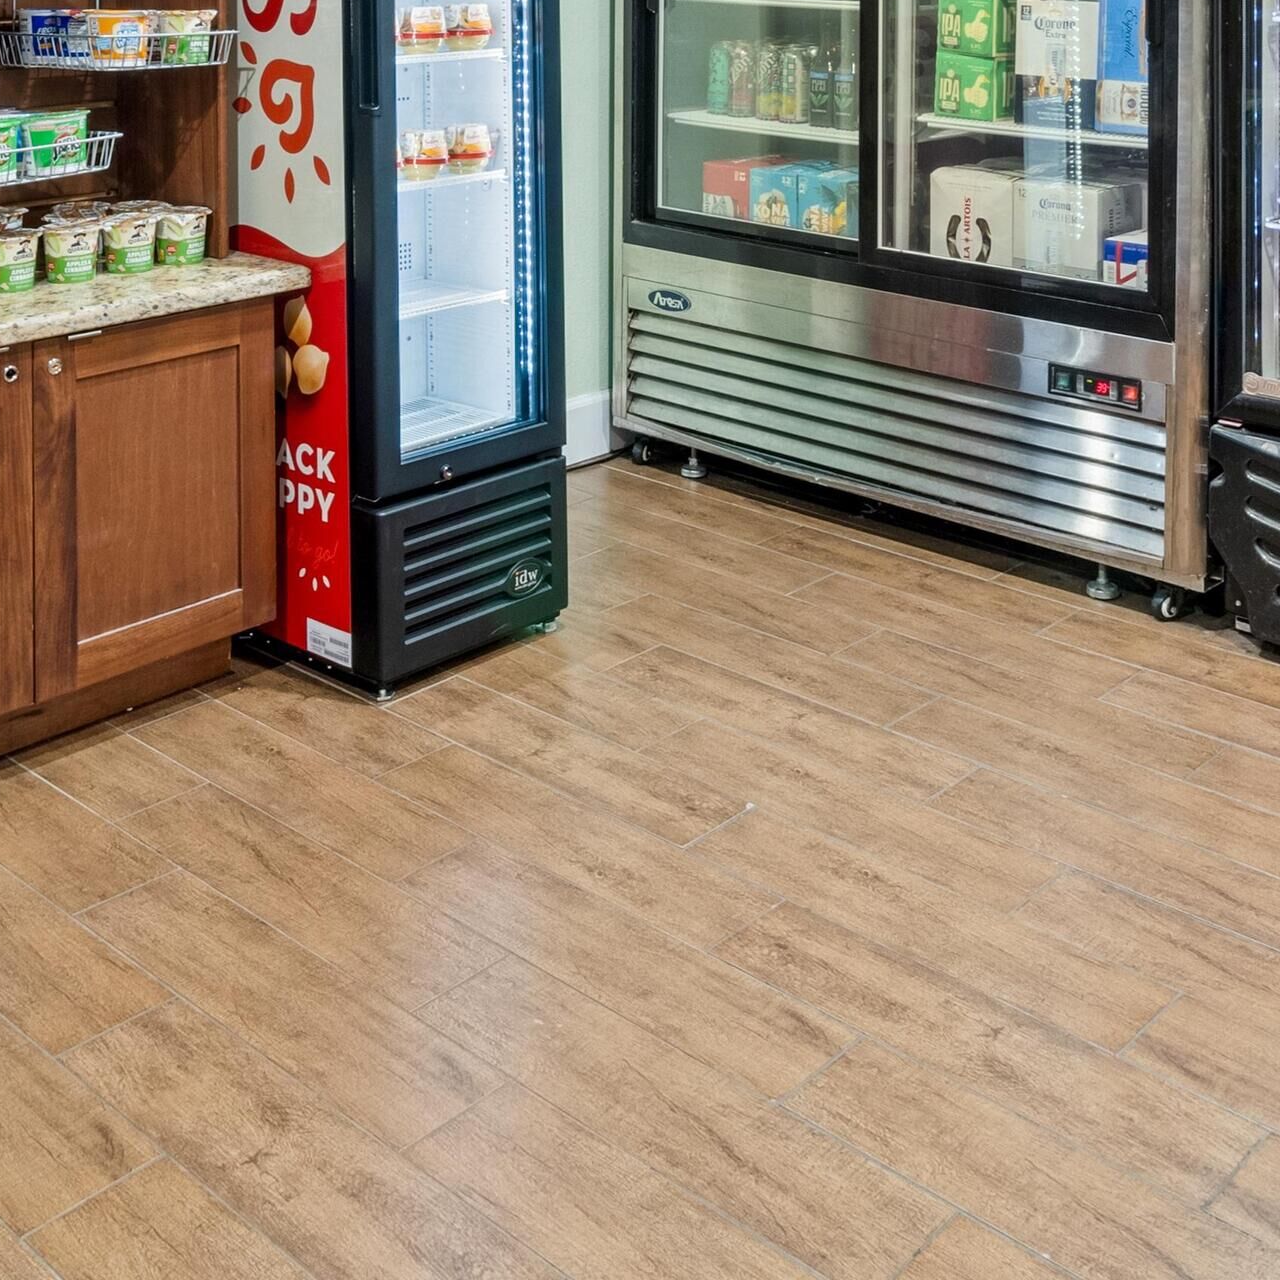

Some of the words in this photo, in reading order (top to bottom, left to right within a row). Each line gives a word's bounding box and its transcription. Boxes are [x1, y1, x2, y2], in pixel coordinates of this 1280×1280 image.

[942, 13, 961, 37] IPA
[1044, 31, 1067, 40] Extra
[939, 78, 960, 102] IPA
[754, 203, 790, 218] KONA
[962, 196, 972, 235] ARTOIS
[1039, 198, 1072, 211] Corona
[276, 438, 336, 484] ACK
[279, 478, 335, 523] PPY
[514, 569, 538, 586] idw
